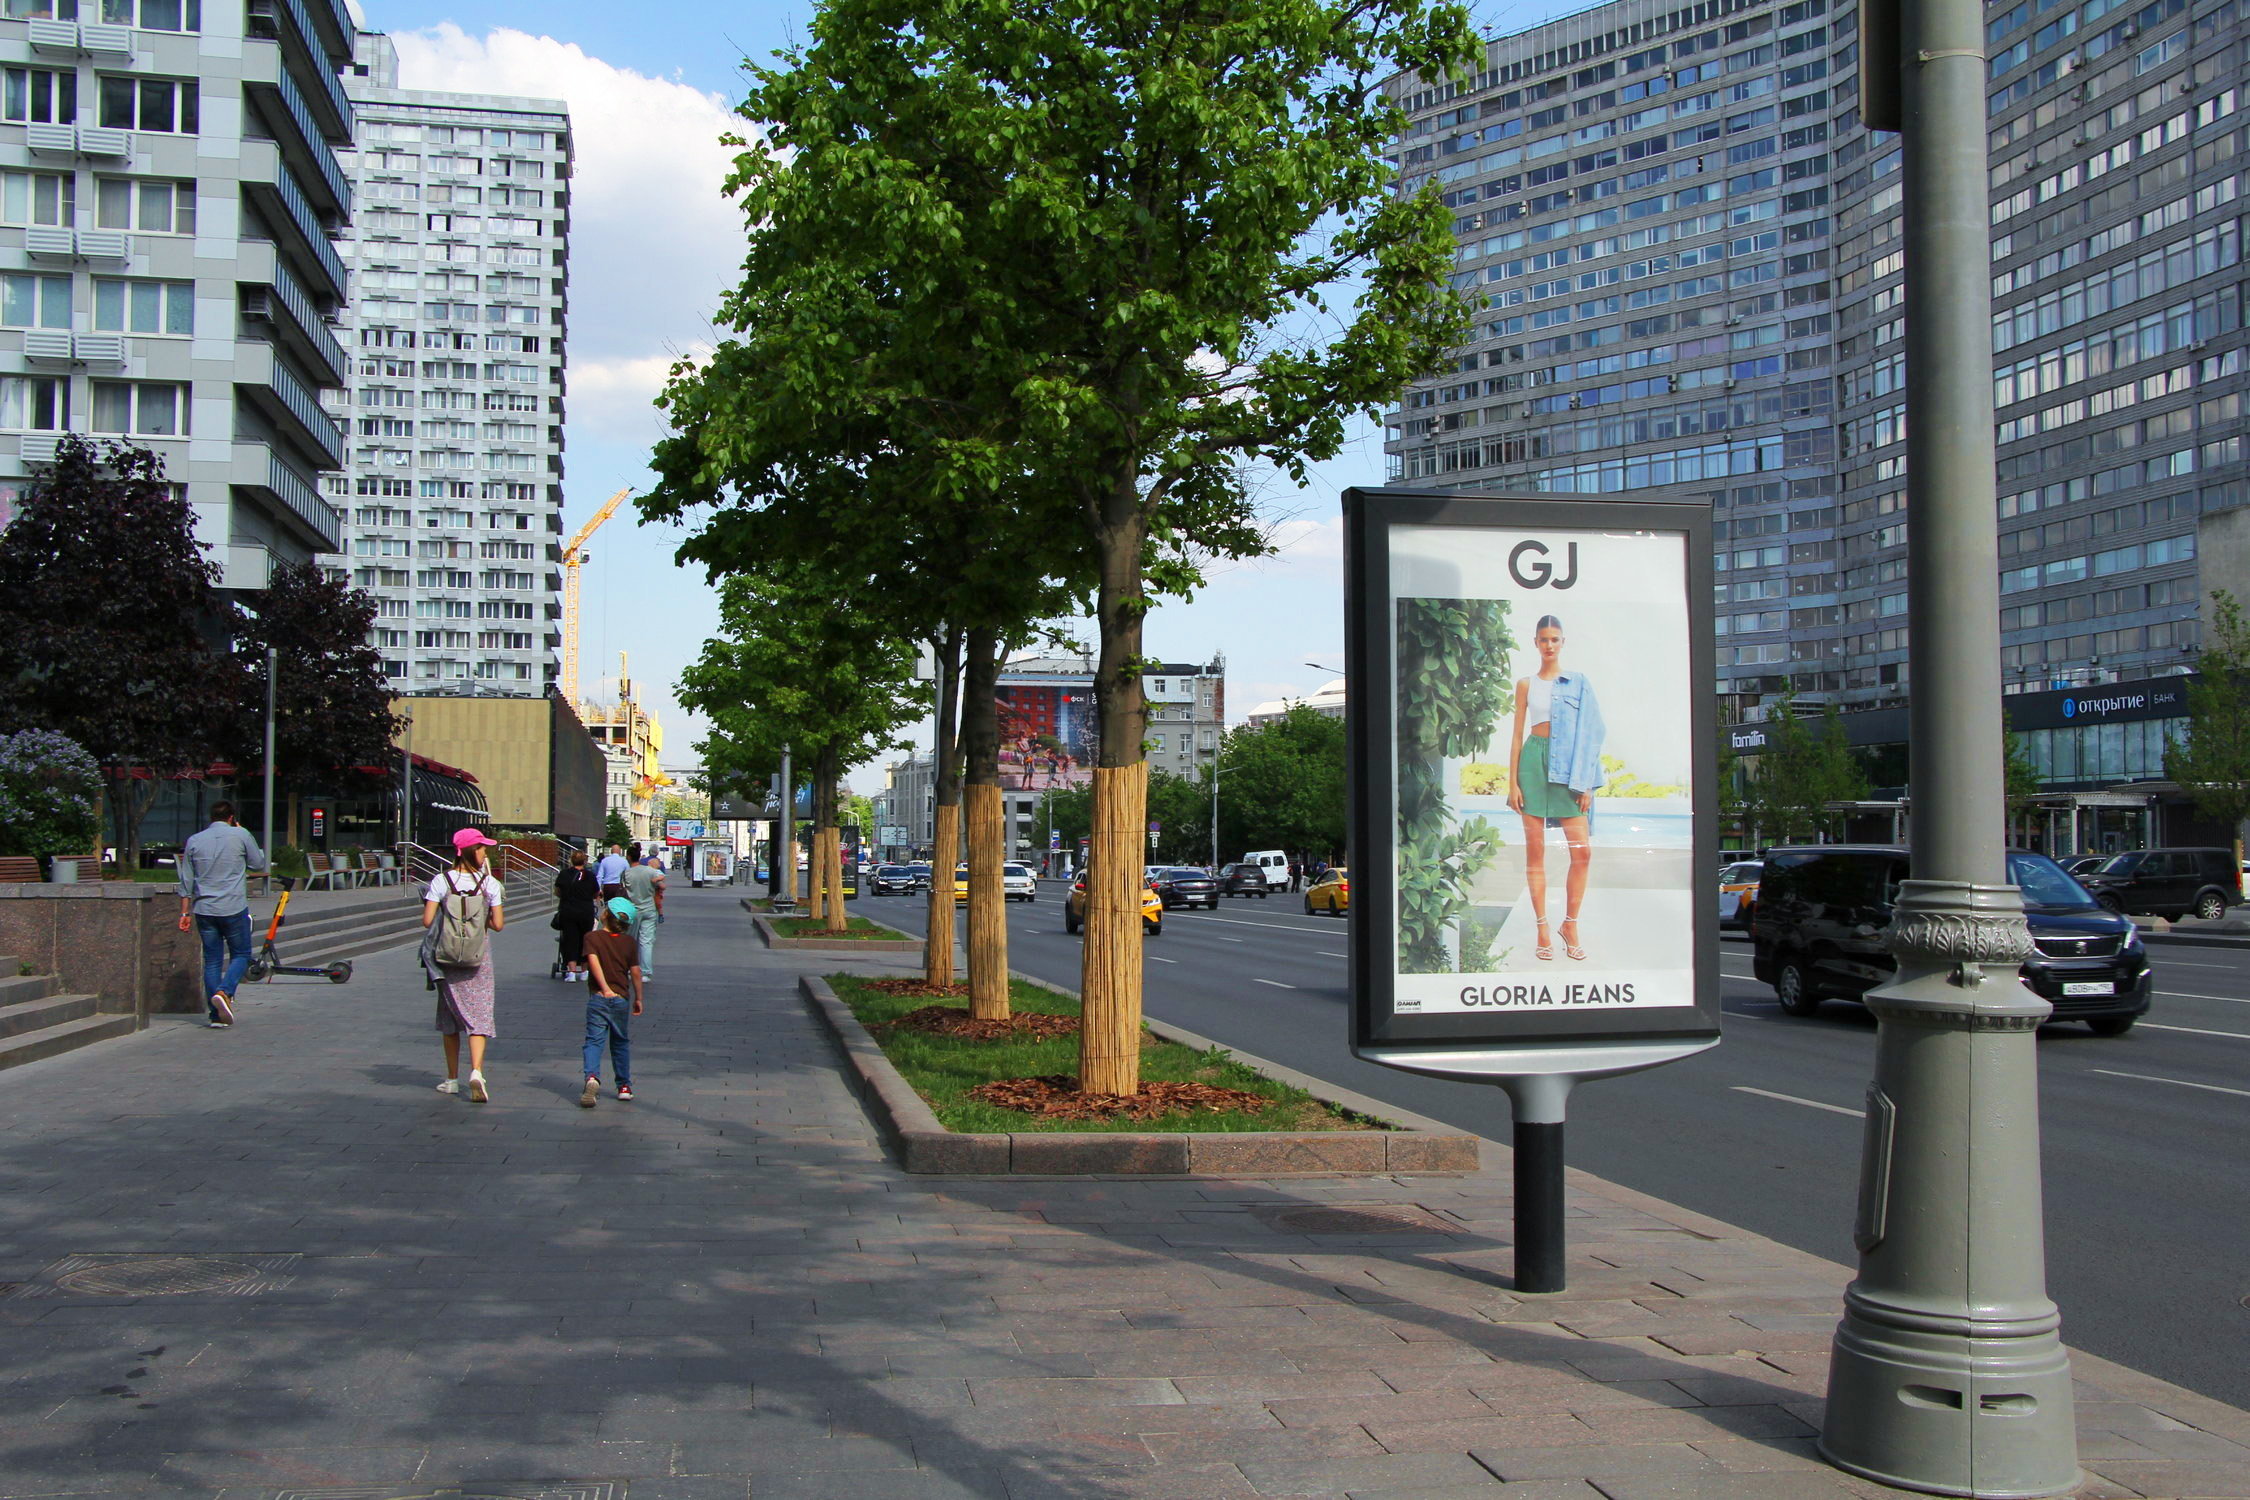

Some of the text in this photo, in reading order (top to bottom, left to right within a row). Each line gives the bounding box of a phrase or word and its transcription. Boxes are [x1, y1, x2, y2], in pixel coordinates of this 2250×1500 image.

[1508, 539, 1578, 590] GJ
[2078, 692, 2176, 717] открытие БАНК
[1460, 983, 1635, 1007] GLORIA JEANS
